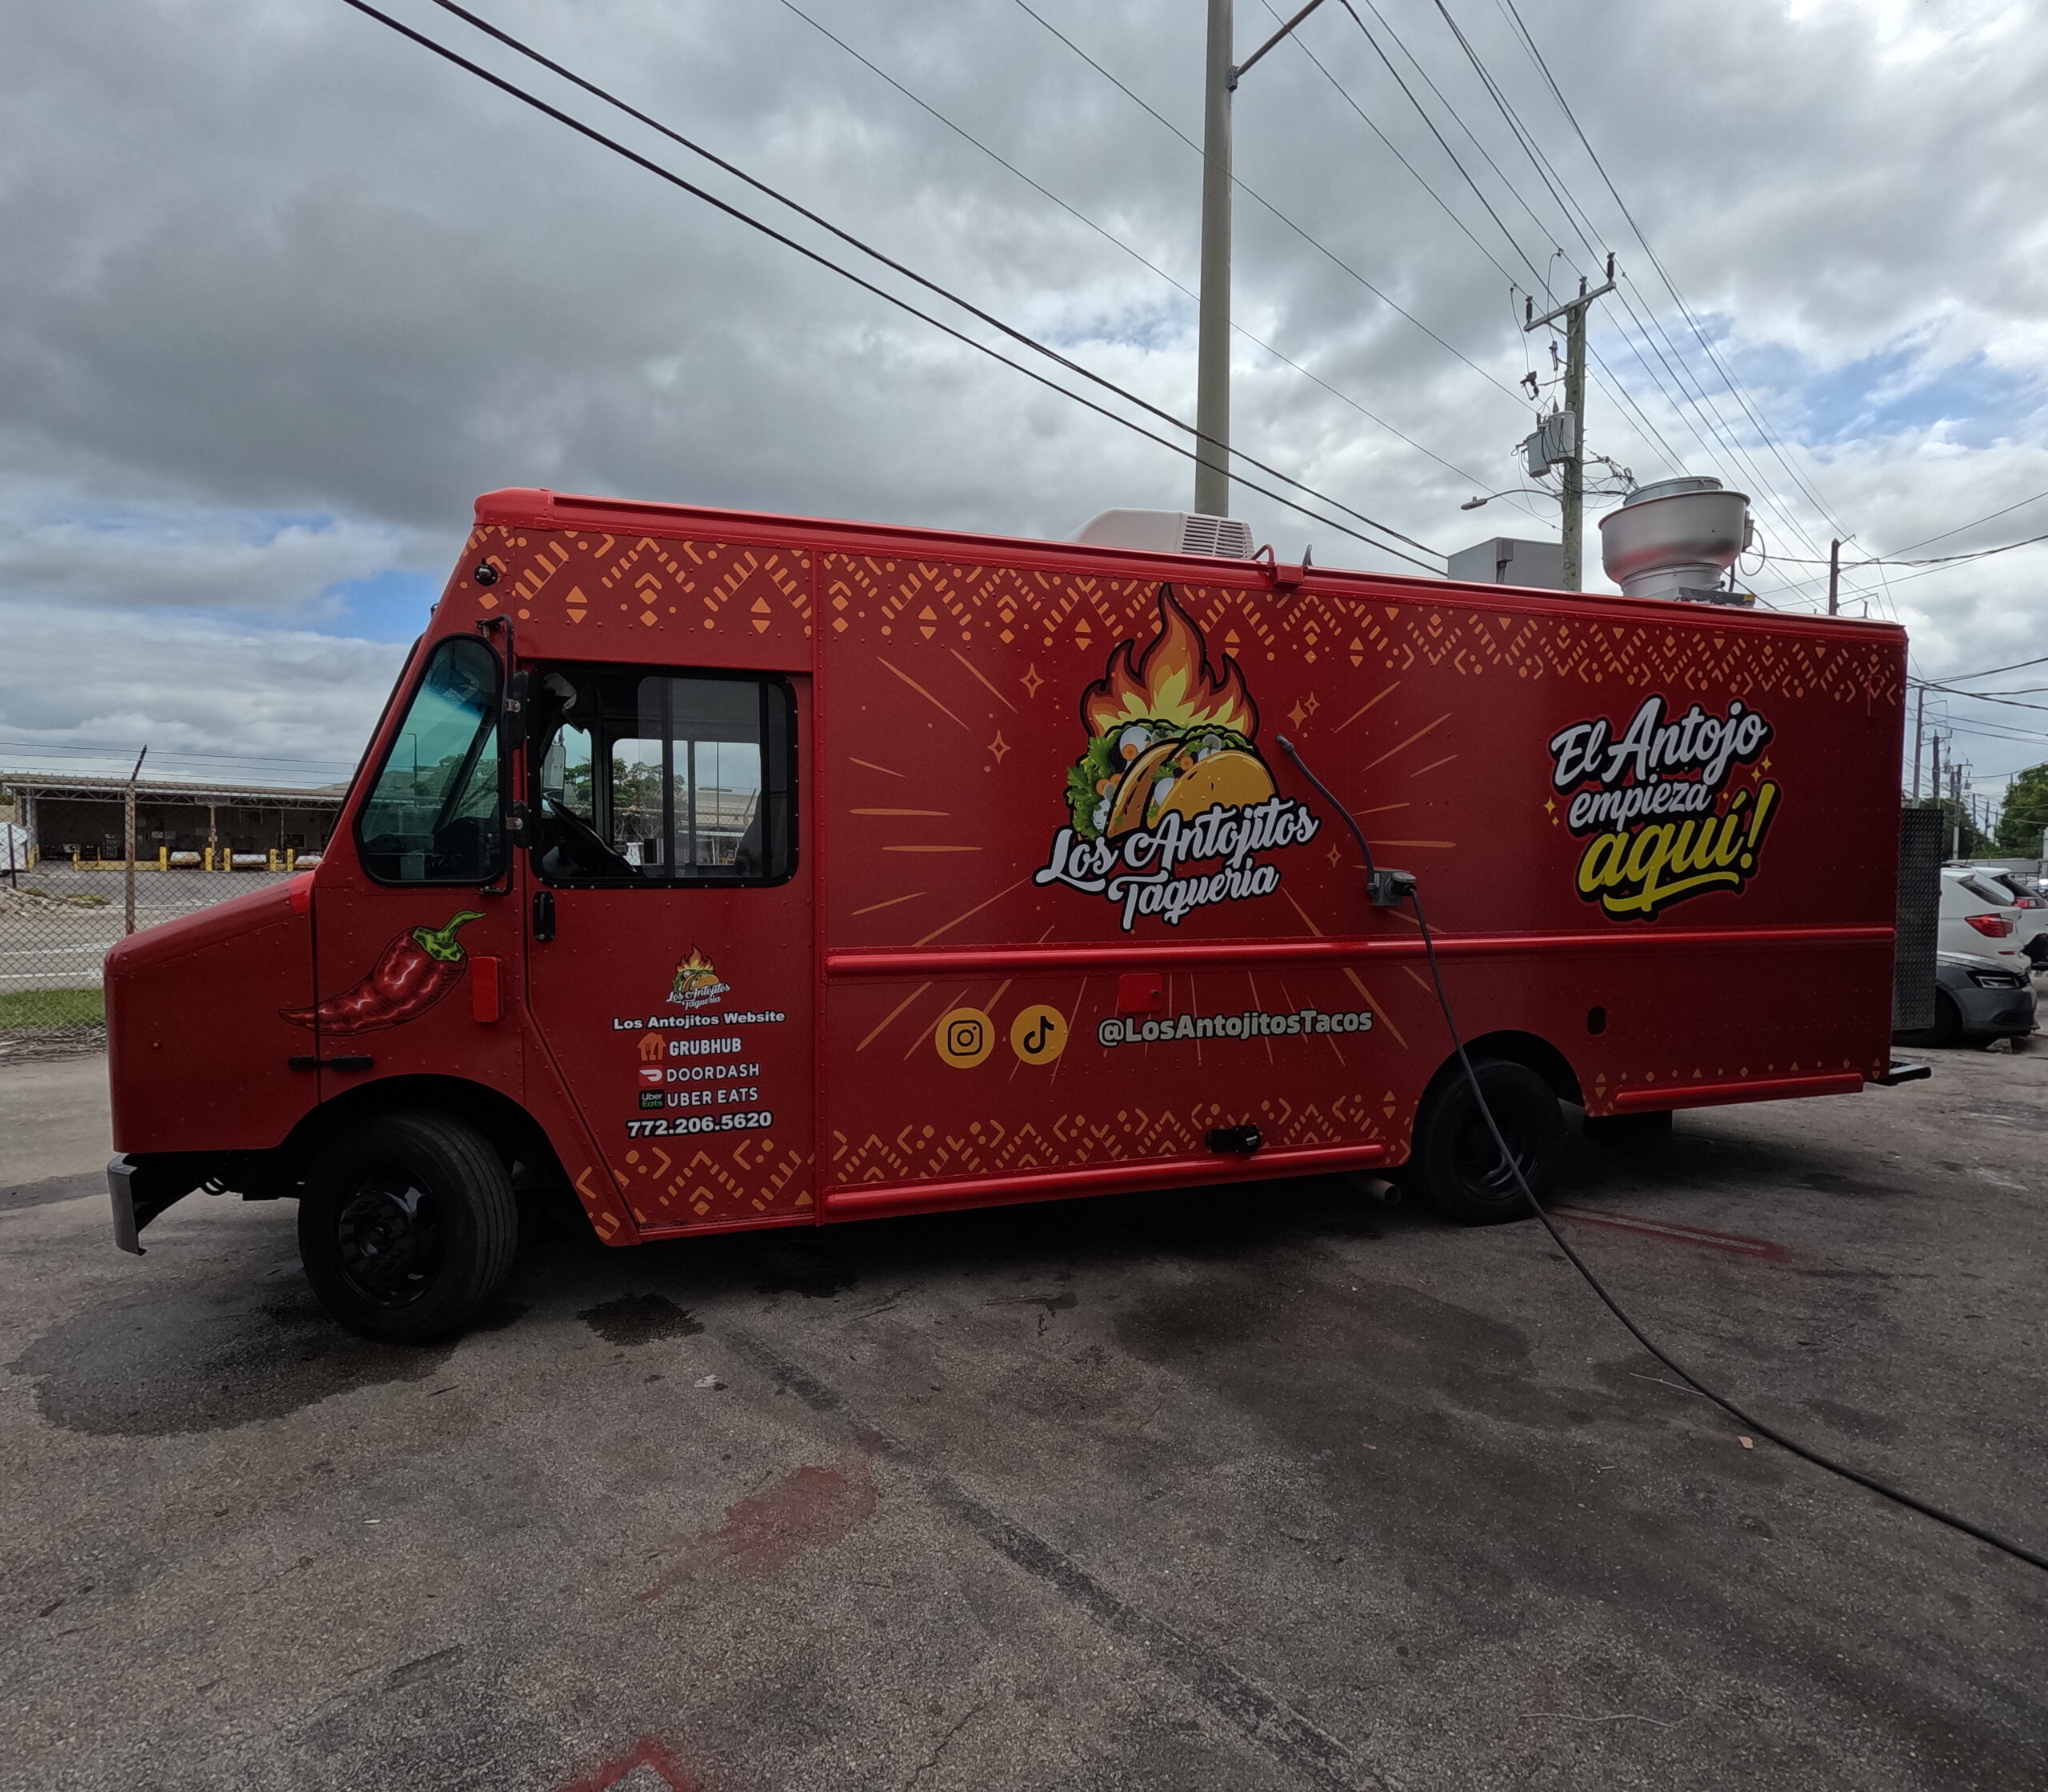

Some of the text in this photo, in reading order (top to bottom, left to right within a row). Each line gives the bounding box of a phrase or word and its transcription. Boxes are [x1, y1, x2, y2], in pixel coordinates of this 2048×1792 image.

[1551, 698, 1767, 786] El Antojo
[1570, 774, 1711, 832] empieza
[1036, 798, 1319, 892] Los Antojitos
[1579, 783, 1775, 912] aquí!
[666, 982, 730, 1003] Los Antojitos
[614, 1011, 786, 1030] Los Antojitos Website
[1099, 1010, 1373, 1046] @LosAntojitosTacos
[669, 1038, 742, 1056] GRUBHUB
[666, 1063, 759, 1082] DOORDASH
[642, 1093, 662, 1101] Uber
[667, 1087, 758, 1107] UBER EATS
[627, 1112, 772, 1137] 772.206.5620
